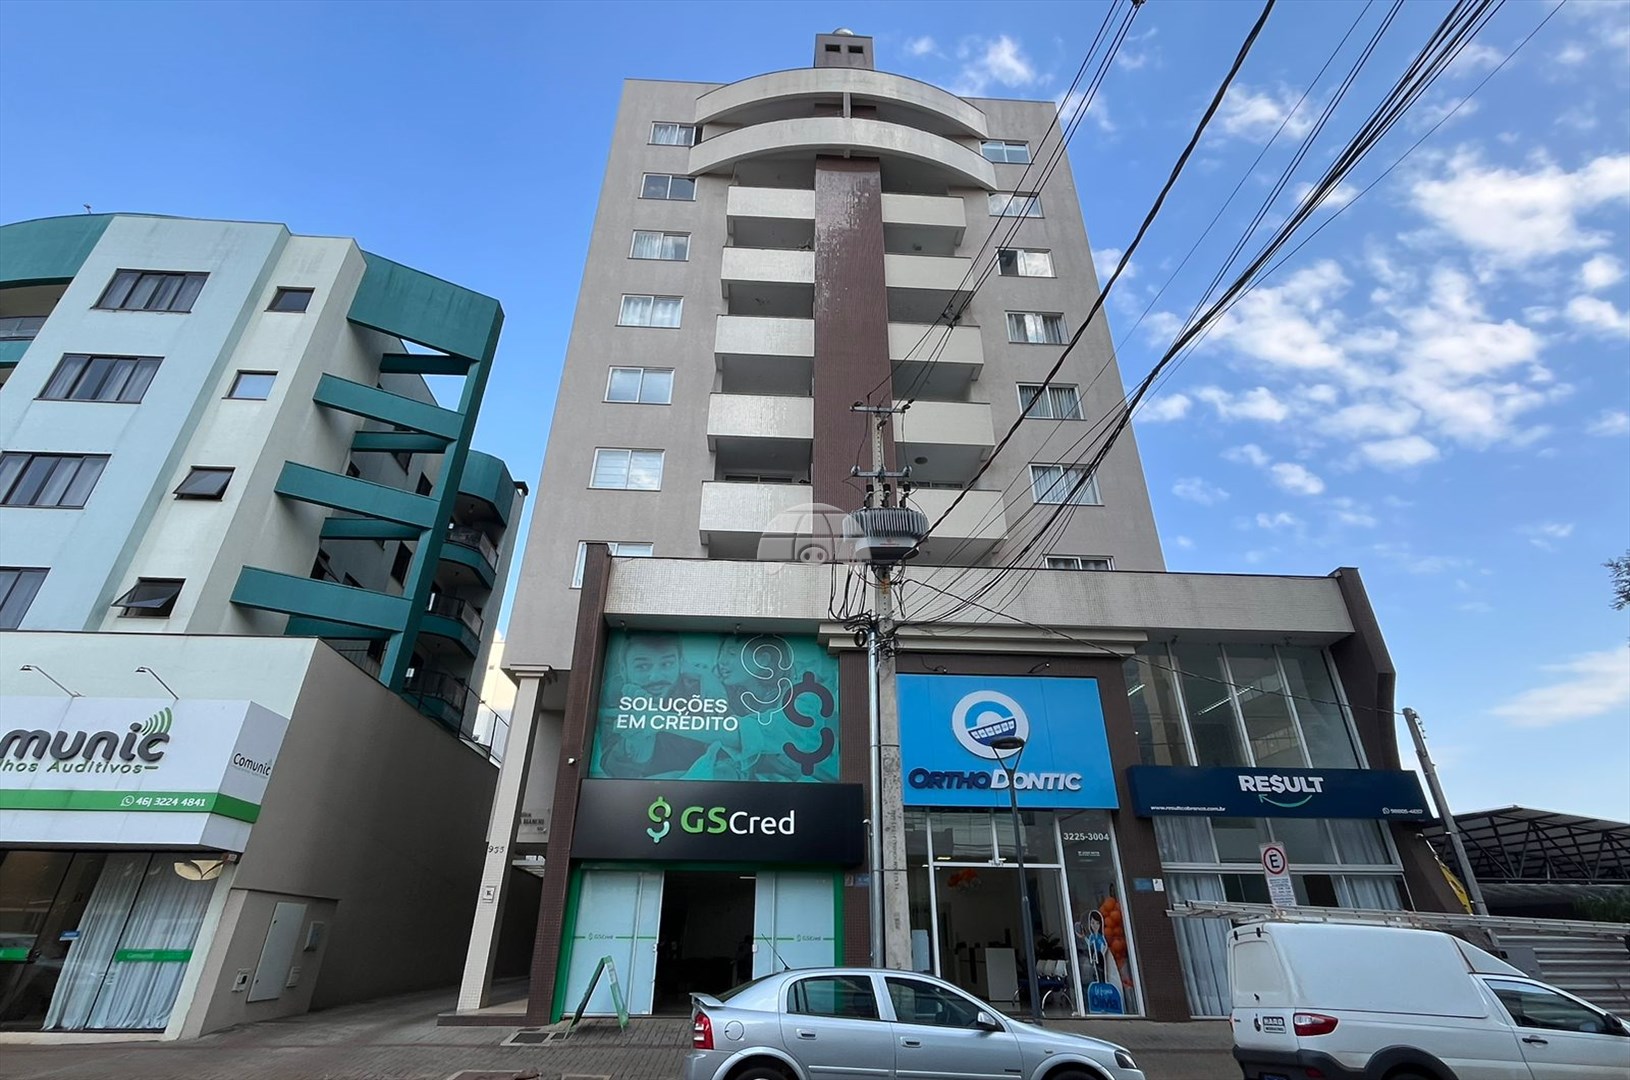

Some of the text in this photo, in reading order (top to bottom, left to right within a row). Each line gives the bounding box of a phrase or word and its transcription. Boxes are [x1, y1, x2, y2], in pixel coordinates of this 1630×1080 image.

[619, 694, 728, 715] SOLUÇÕES
[616, 711, 739, 731] EM CRÉDITO
[46, 760, 142, 774] Auditivos
[233, 752, 271, 776] Comunic
[153, 797, 179, 806] 3224
[180, 797, 206, 807] 4841
[680, 806, 795, 835] GSCred
[1063, 832, 1110, 841] 3225-3004
[1269, 854, 1280, 869] E
